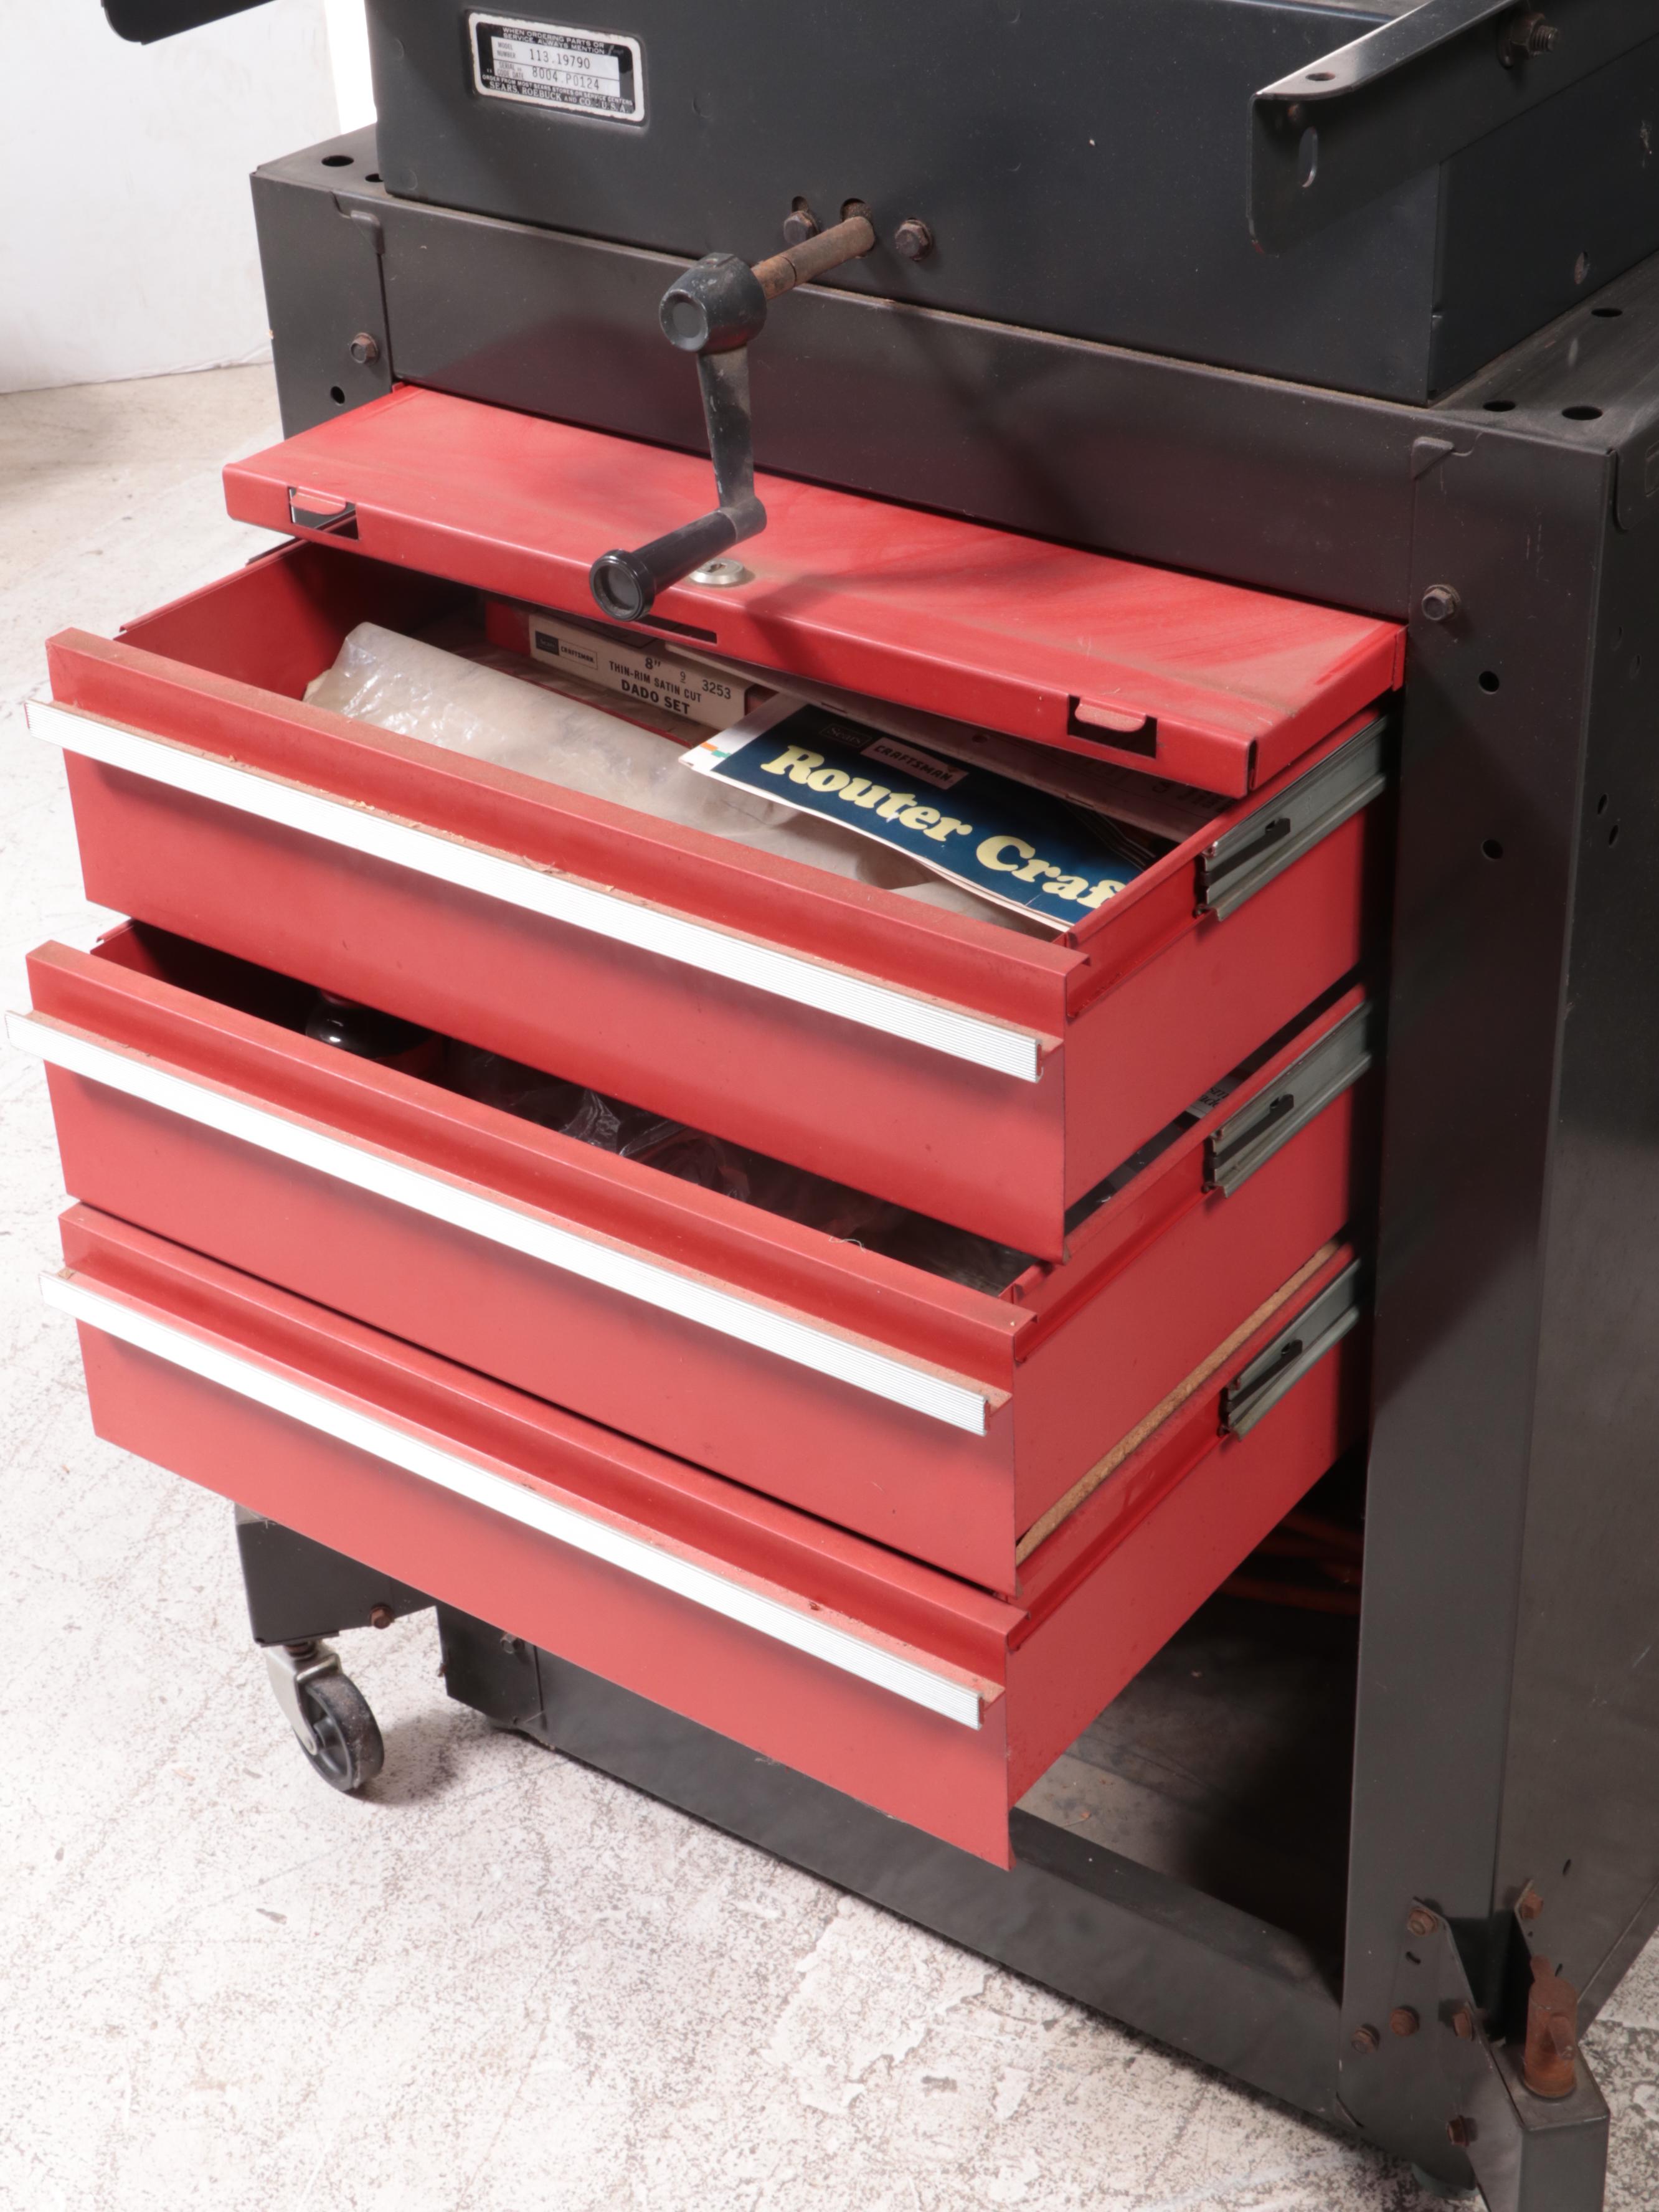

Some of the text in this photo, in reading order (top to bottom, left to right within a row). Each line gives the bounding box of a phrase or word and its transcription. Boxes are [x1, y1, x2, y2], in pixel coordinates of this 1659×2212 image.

[498, 42, 513, 50] MODEL
[503, 27, 524, 35] WHEN
[527, 31, 564, 42] ORDERING
[567, 37, 591, 47] PARTS
[537, 38, 568, 49] ALWAYS
[571, 44, 605, 54] MENTION
[497, 50, 516, 59] NUMBER
[497, 69, 510, 77] CODE
[513, 71, 524, 80] DATE
[499, 62, 515, 70] SERIAL
[522, 87, 562, 100] ROEBUCK
[564, 95, 577, 103] AND
[533, 82, 551, 90] SEARS
[552, 86, 574, 95] STORES
[584, 92, 606, 100] SERVICE
[607, 96, 633, 106] CENTERS
[560, 646, 595, 663] CRAFTSMAN
[609, 660, 702, 703] THIN-RIM SATIN CUT
[702, 679, 732, 700] 3253
[621, 679, 690, 715] DADO SET
[826, 726, 953, 782] Sears CRAFTSMAN
[760, 745, 1127, 909] Router Craf
